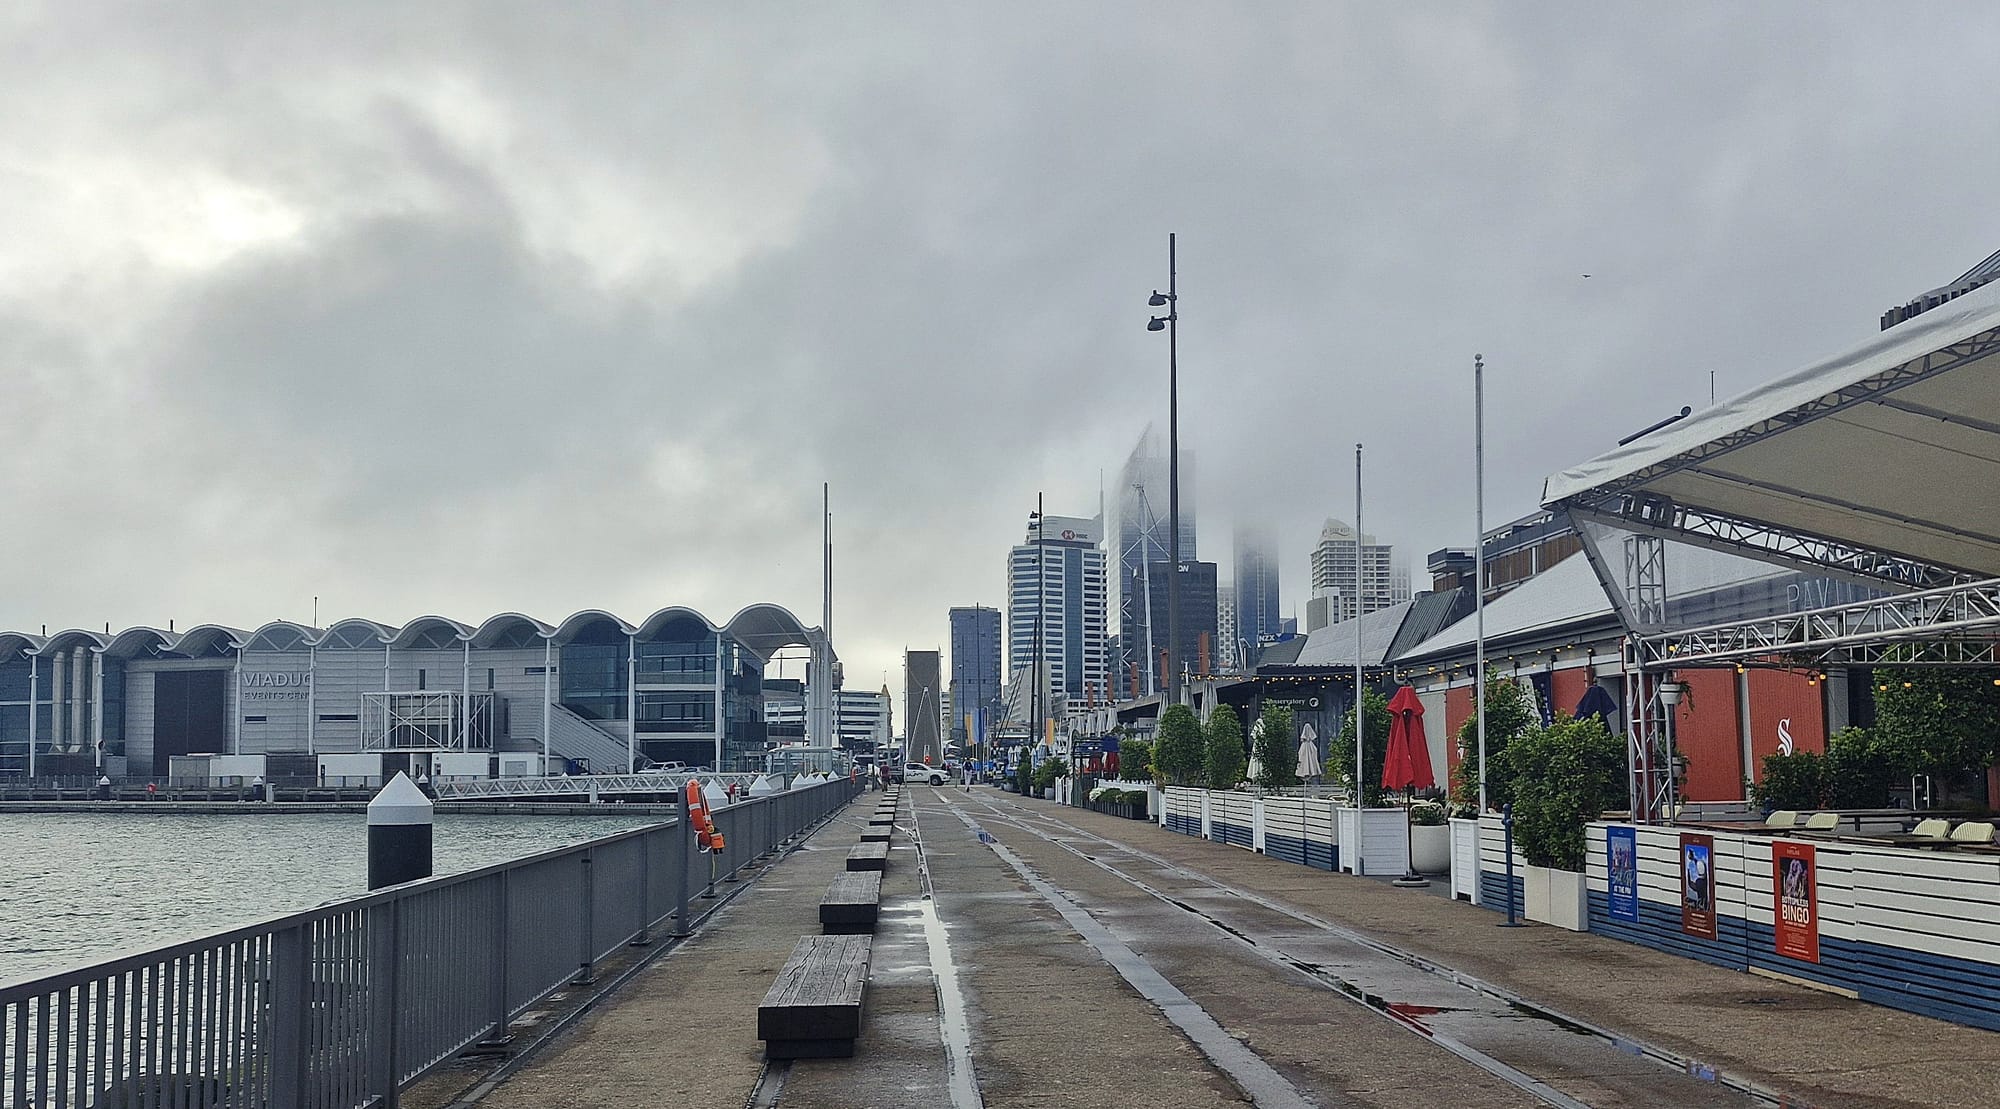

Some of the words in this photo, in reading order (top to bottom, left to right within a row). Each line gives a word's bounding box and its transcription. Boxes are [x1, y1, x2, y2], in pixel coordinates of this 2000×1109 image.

[1258, 634, 1276, 642] NZX
[244, 691, 285, 701] EVENTS
[287, 691, 309, 701] CEN
[1781, 896, 1809, 908] BOTTOMLESS
[1781, 904, 1810, 925] BINGO
